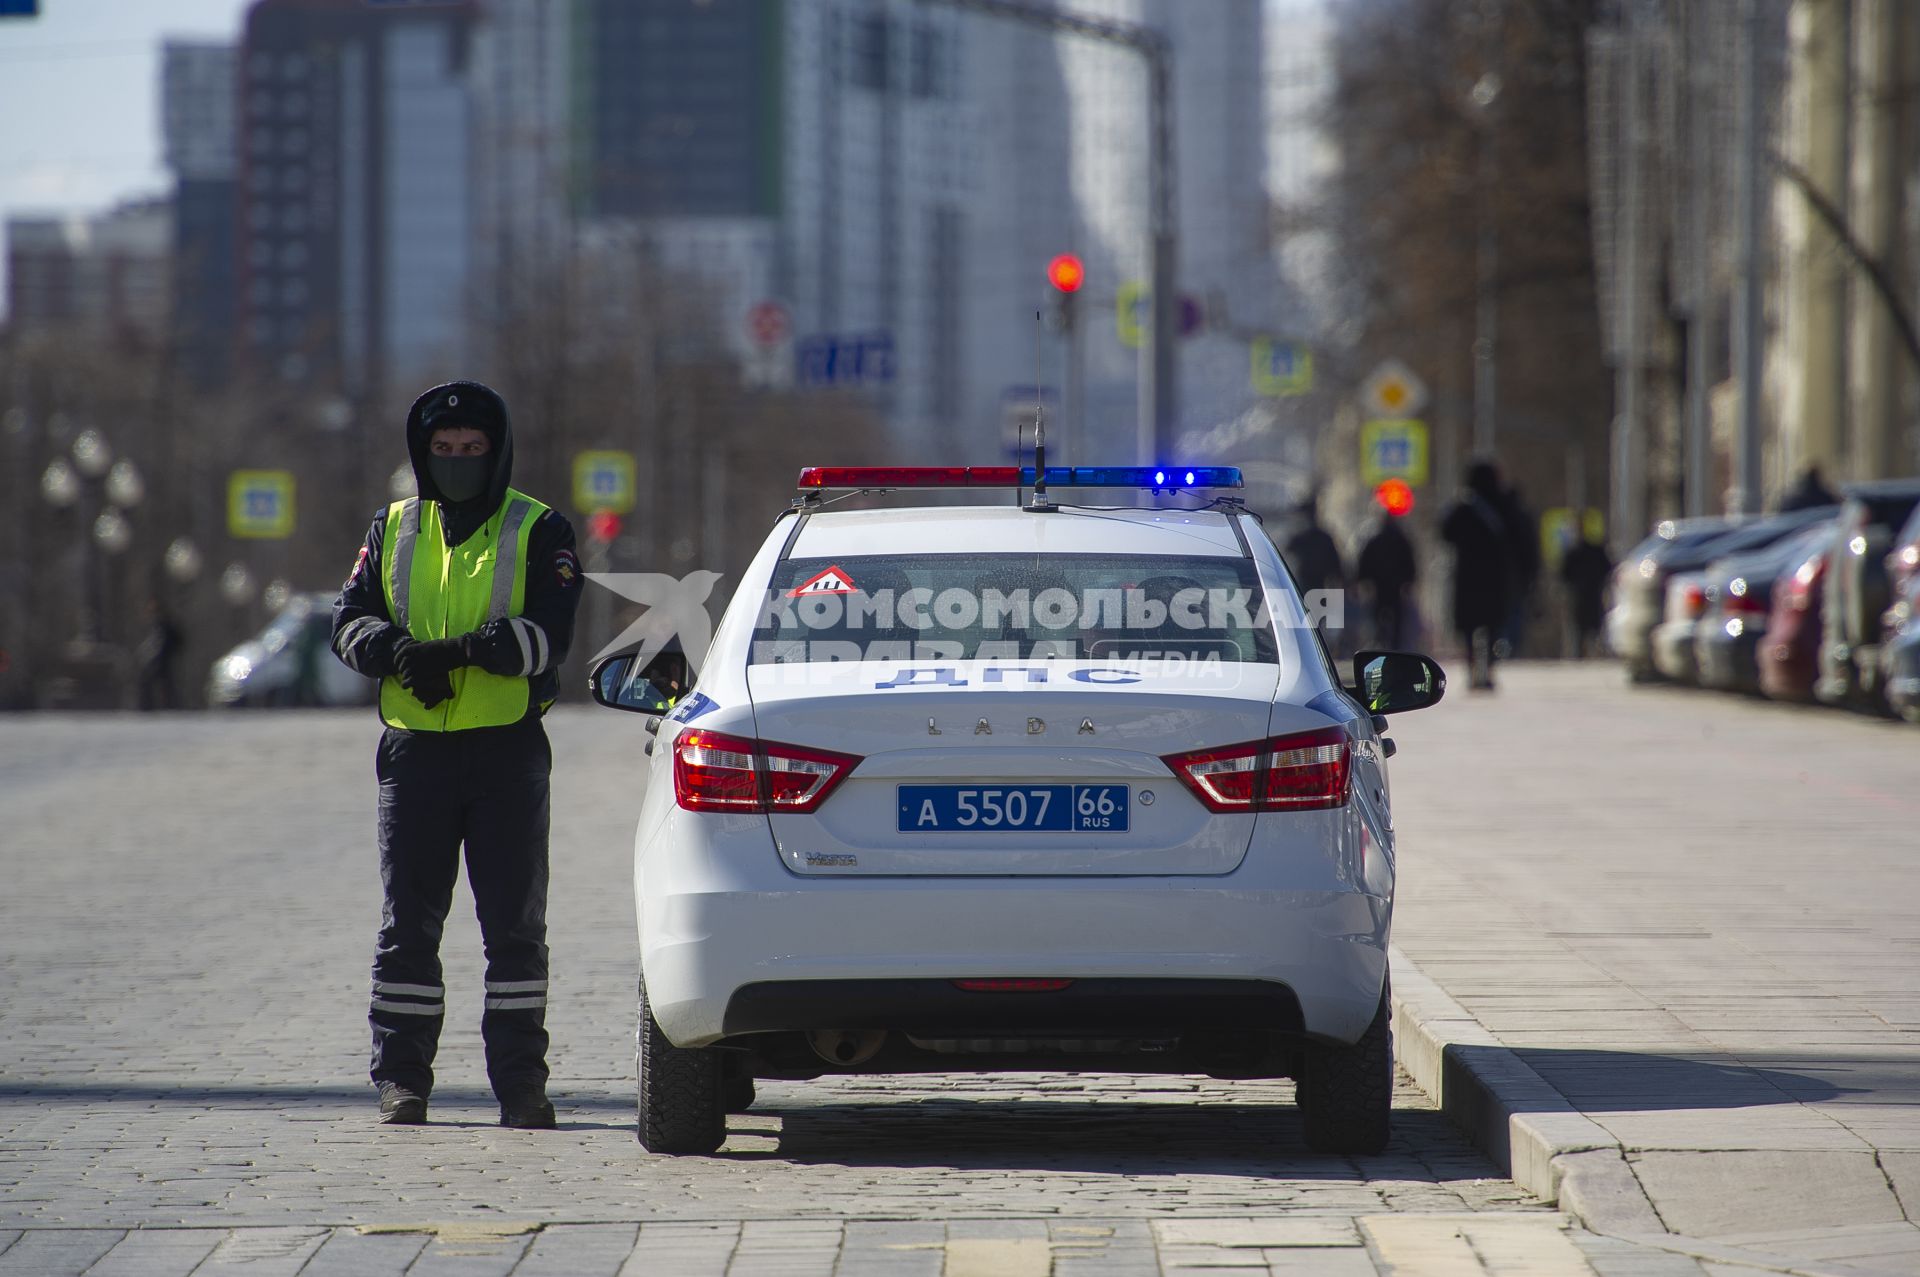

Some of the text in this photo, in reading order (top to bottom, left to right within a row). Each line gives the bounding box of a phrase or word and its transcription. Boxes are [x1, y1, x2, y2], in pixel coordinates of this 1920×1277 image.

[875, 667, 1143, 690] ДПС
[927, 716, 1096, 735] LADA
[956, 790, 1052, 827] 5507
[1077, 788, 1115, 817] 66
[1082, 816, 1111, 828] RUS
